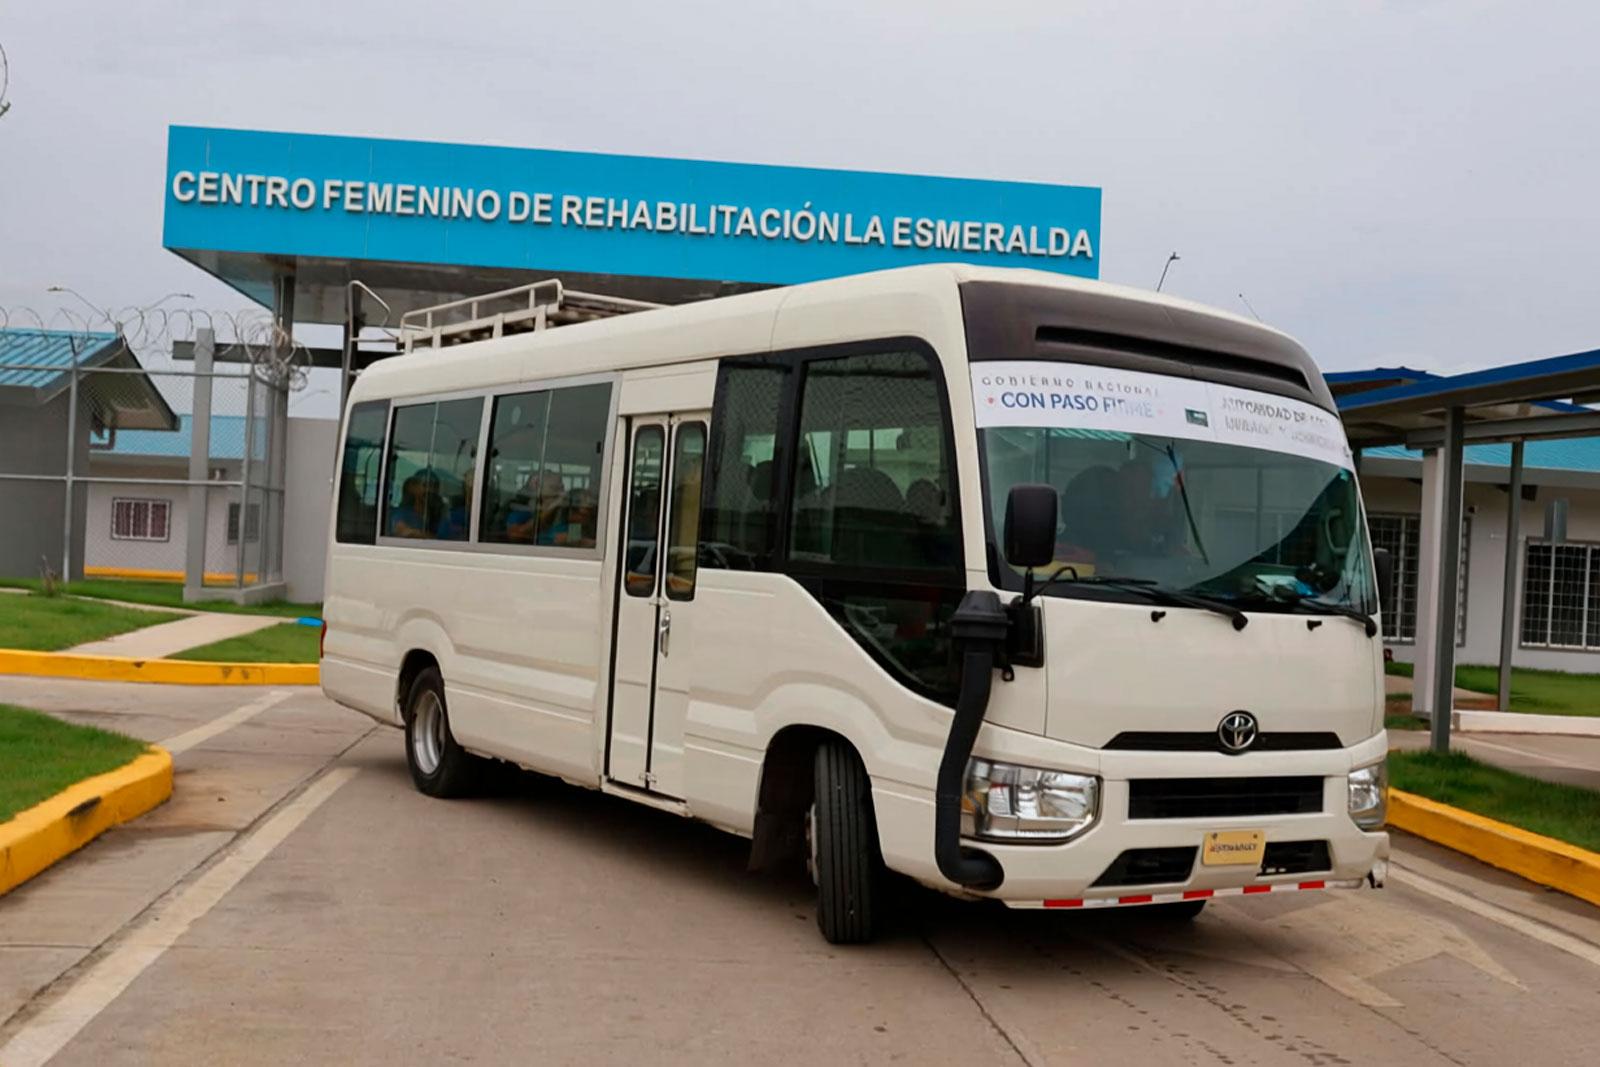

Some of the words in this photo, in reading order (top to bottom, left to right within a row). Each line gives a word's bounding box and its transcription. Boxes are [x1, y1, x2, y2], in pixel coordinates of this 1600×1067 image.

[172, 170, 316, 209] CENTRO
[323, 179, 501, 221] FEMENINO
[508, 191, 554, 224] DE
[561, 195, 839, 243] REHABILITACIÓN
[844, 214, 886, 245] LA
[892, 217, 1094, 258] ESMERALDA
[982, 375, 1074, 388] GOBIERNO
[1001, 391, 1046, 409] CON
[1050, 393, 1099, 411] PASO
